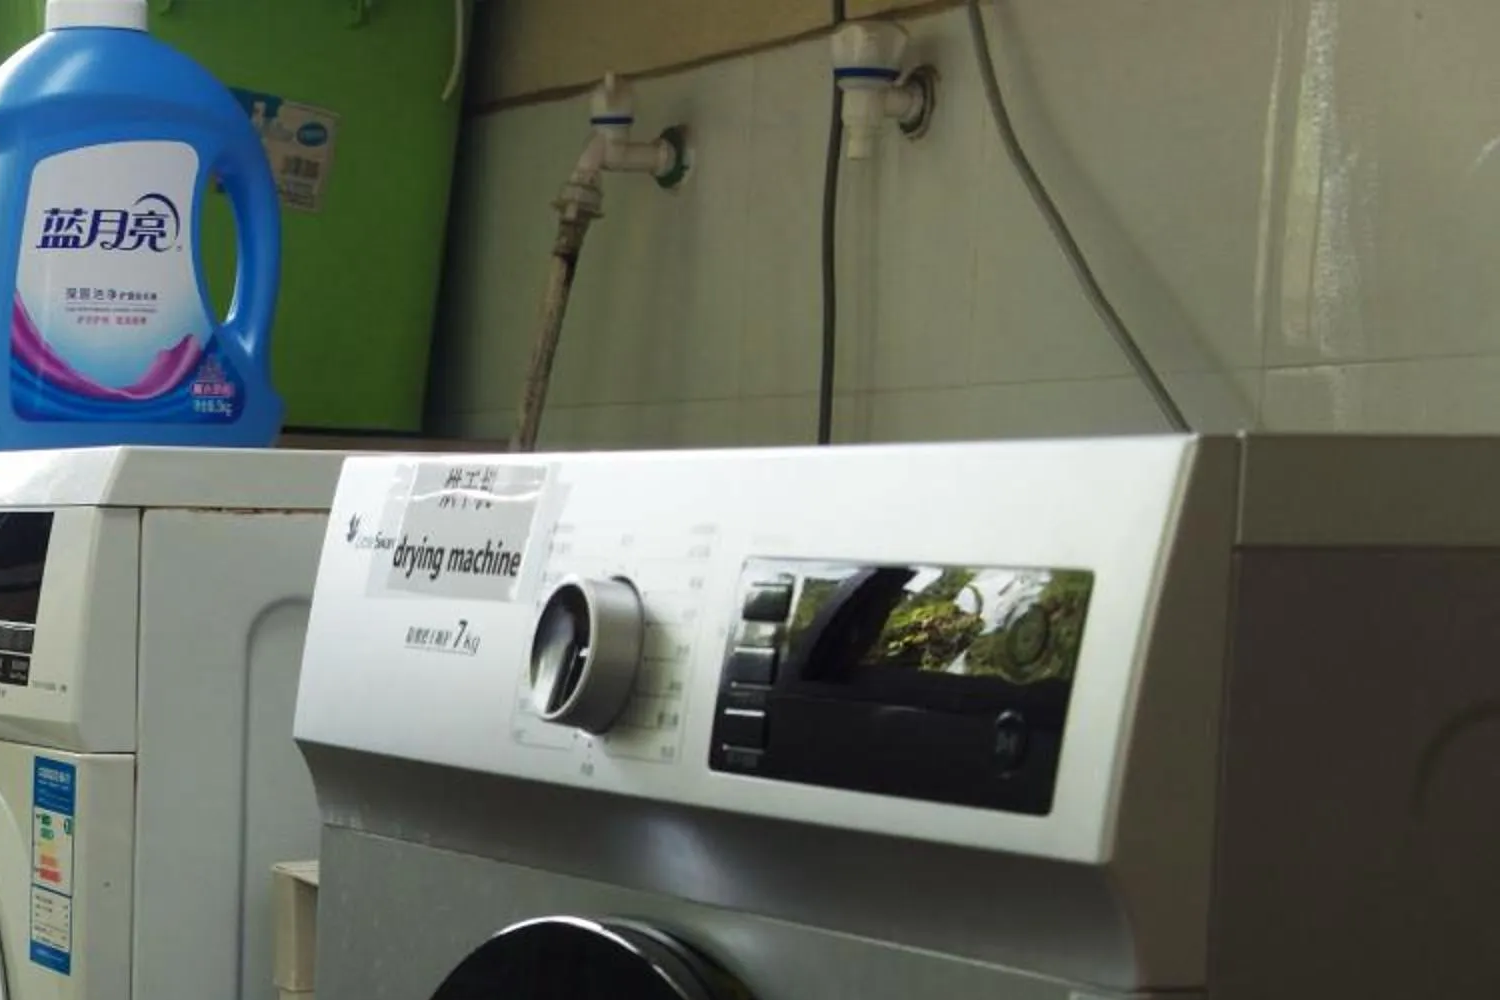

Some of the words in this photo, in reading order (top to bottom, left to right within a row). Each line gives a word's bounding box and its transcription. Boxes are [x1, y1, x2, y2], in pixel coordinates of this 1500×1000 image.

[36, 203, 174, 253] 蓝月亮
[393, 536, 445, 580] drying
[447, 540, 521, 577] machine
